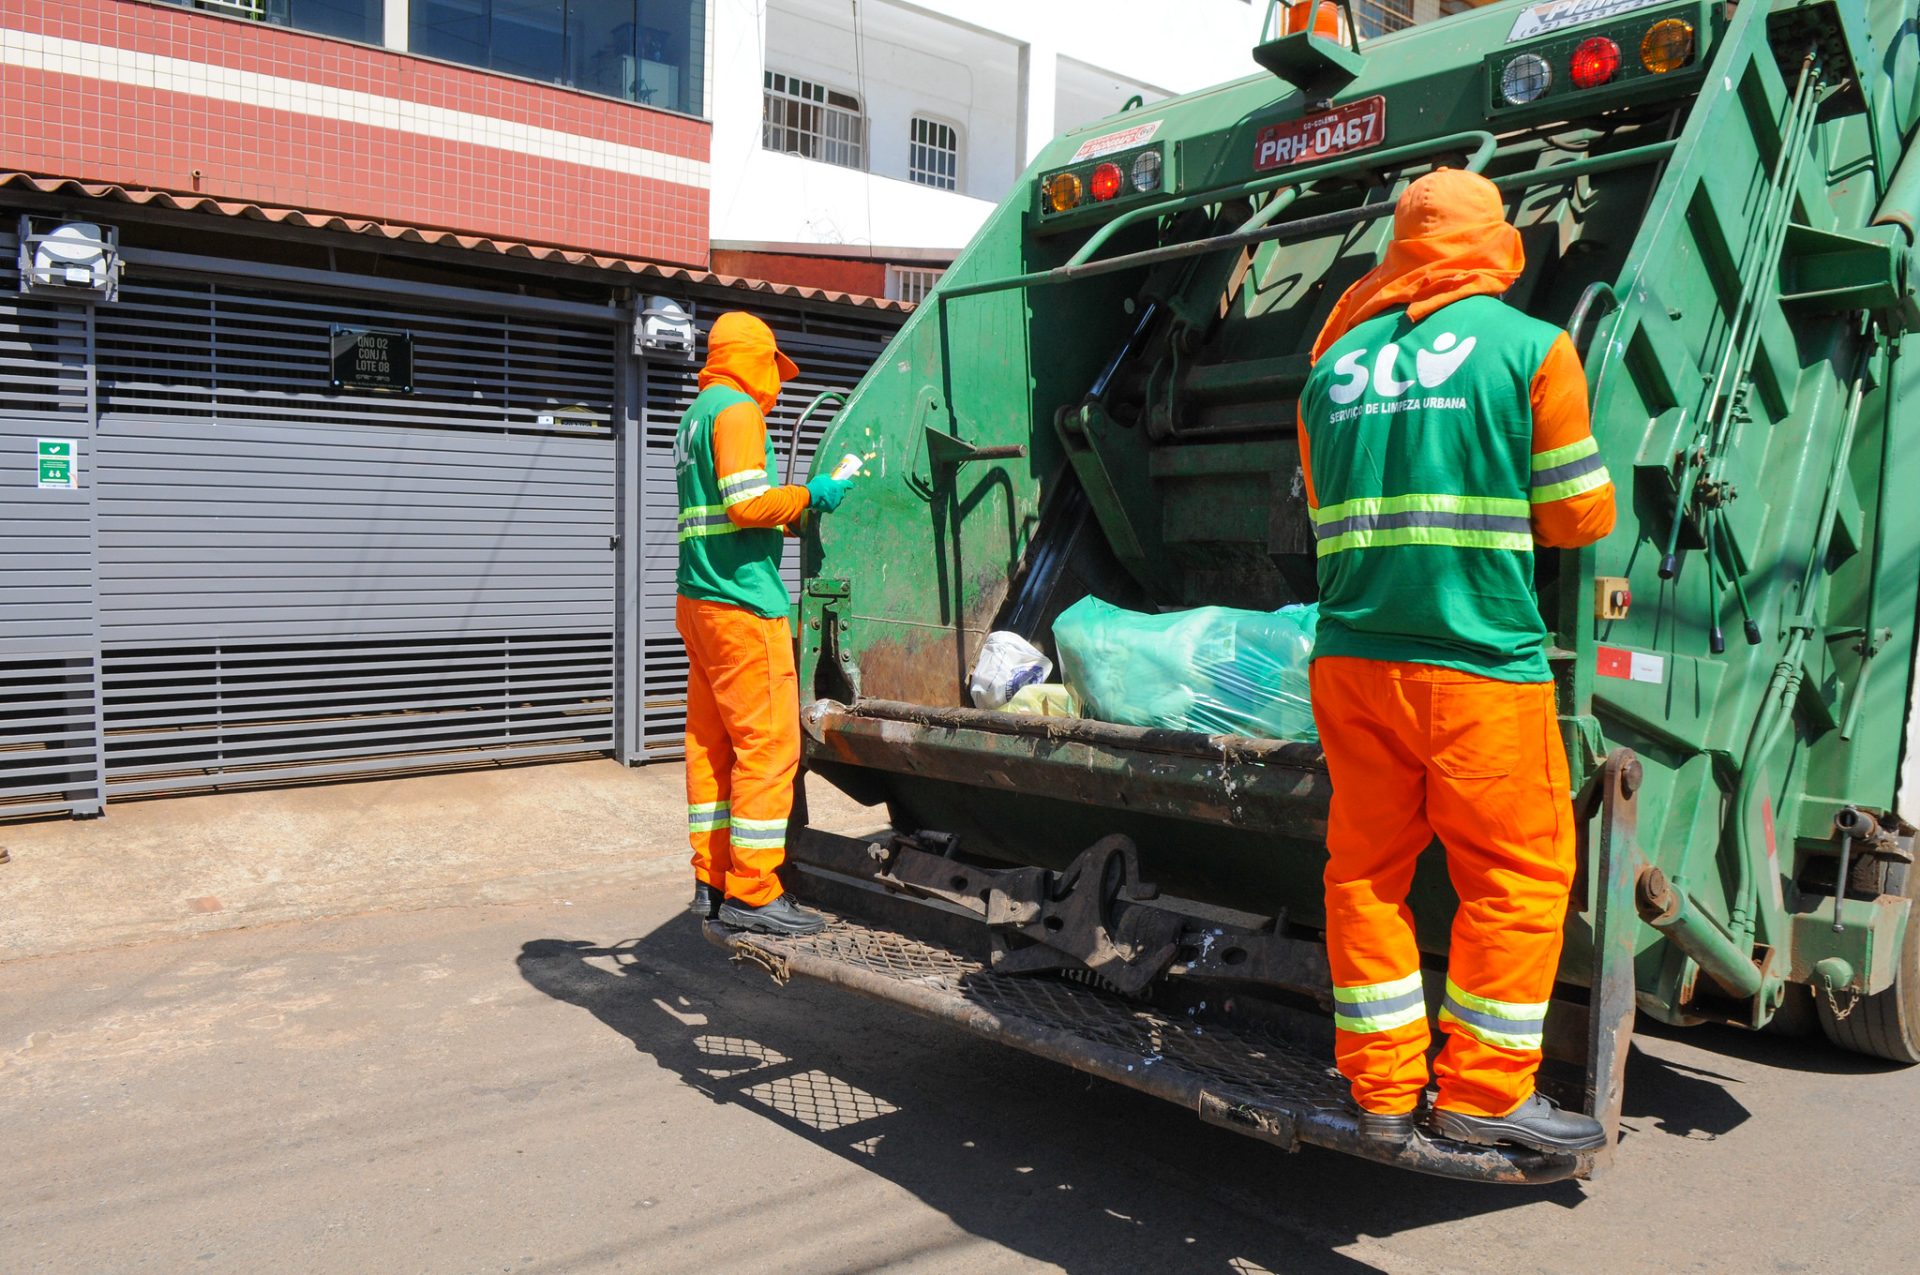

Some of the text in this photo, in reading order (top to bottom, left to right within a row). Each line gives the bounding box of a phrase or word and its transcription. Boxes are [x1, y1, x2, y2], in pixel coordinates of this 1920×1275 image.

[377, 339, 388, 349] 02
[358, 348, 388, 361] CONJ A
[356, 360, 390, 372] LOTE 08
[1329, 396, 1467, 424] SERVIÇO DE LIMPEZA URBANA
